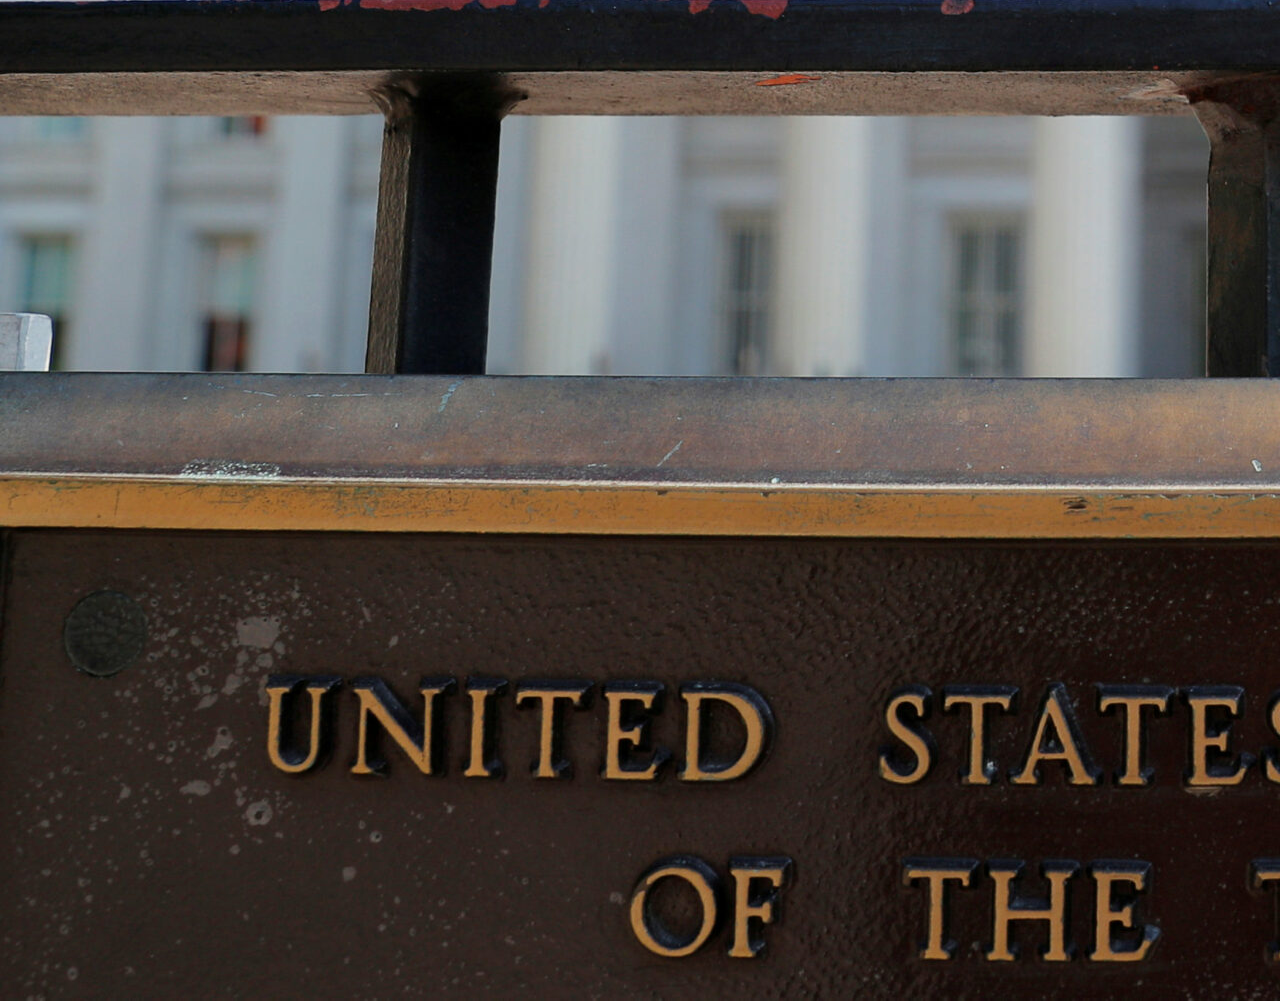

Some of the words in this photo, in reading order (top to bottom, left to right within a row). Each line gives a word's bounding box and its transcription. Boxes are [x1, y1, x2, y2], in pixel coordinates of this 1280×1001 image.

[264, 678, 772, 782] UNITED
[629, 861, 788, 959] OF
[903, 863, 1158, 961] THE
